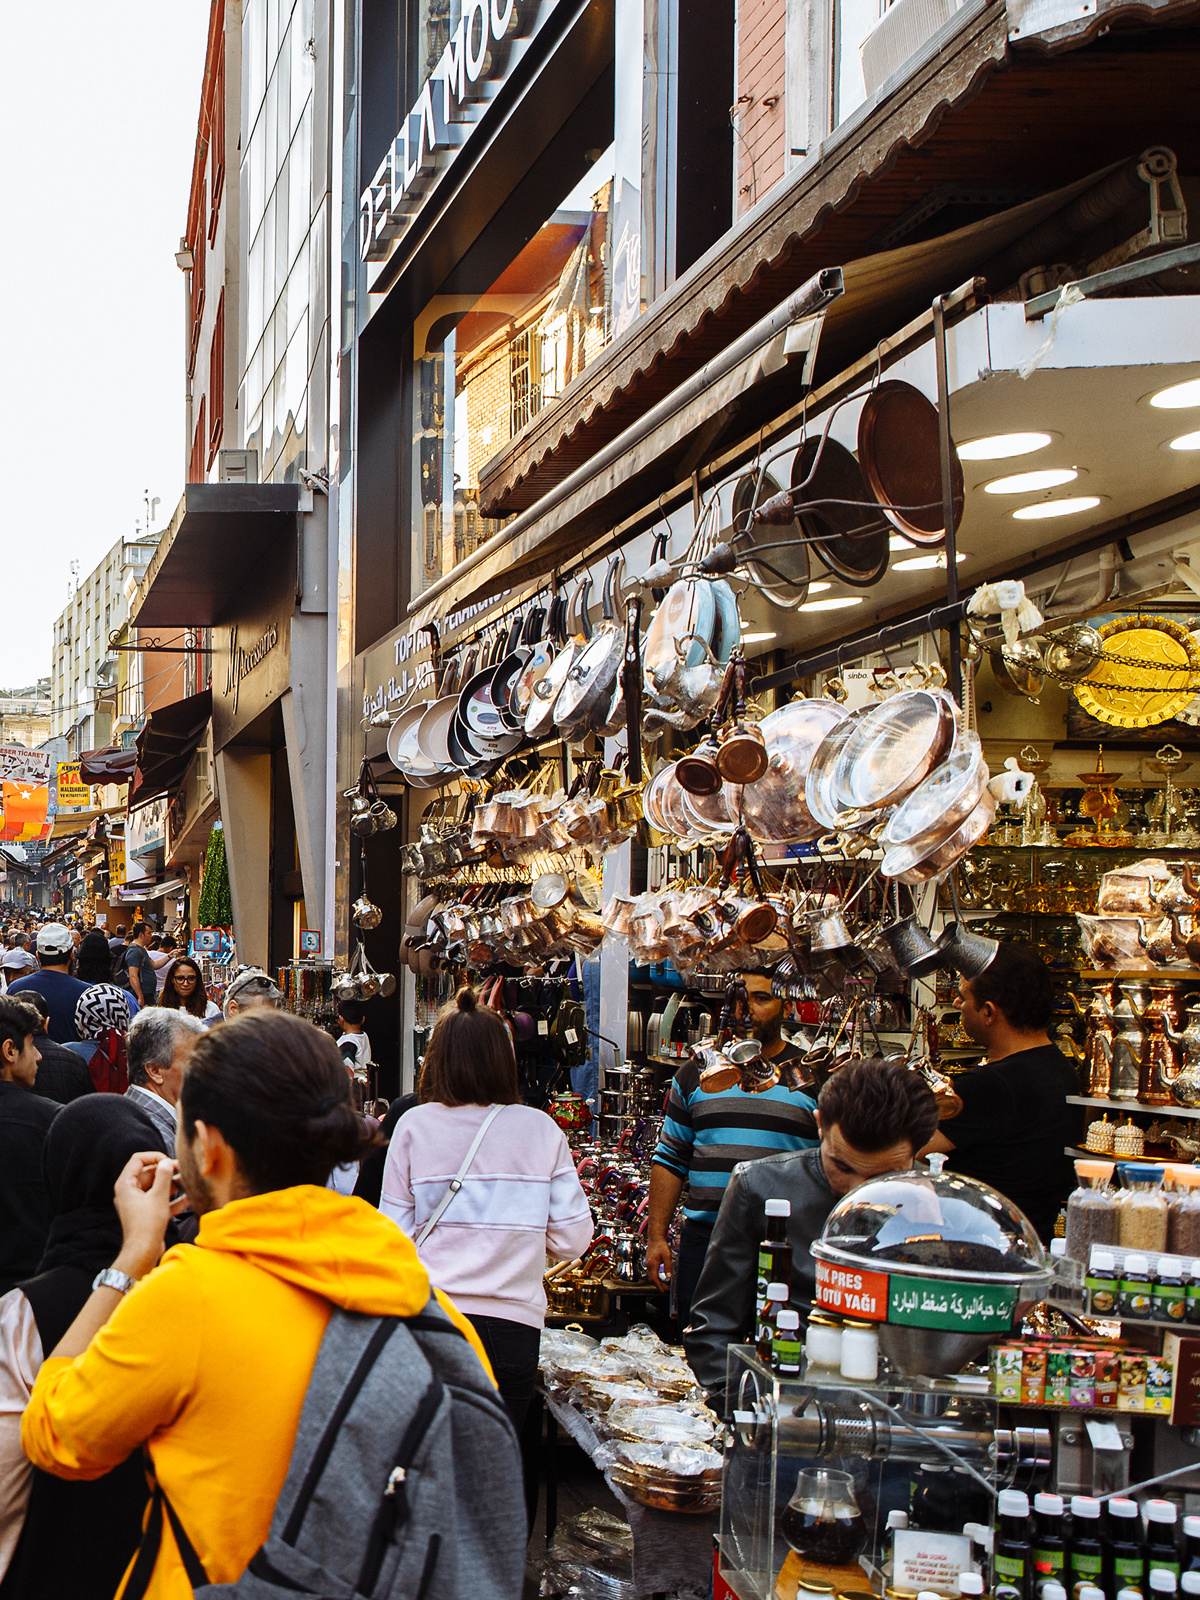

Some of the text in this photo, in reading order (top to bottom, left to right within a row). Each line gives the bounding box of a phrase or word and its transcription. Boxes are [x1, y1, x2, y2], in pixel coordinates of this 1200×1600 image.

[18, 749, 44, 759] TİCARET
[60, 773, 83, 785] HA
[831, 1270, 863, 1290] PRES
[823, 1287, 841, 1306] OTU
[844, 1292, 876, 1313] YAĞI
